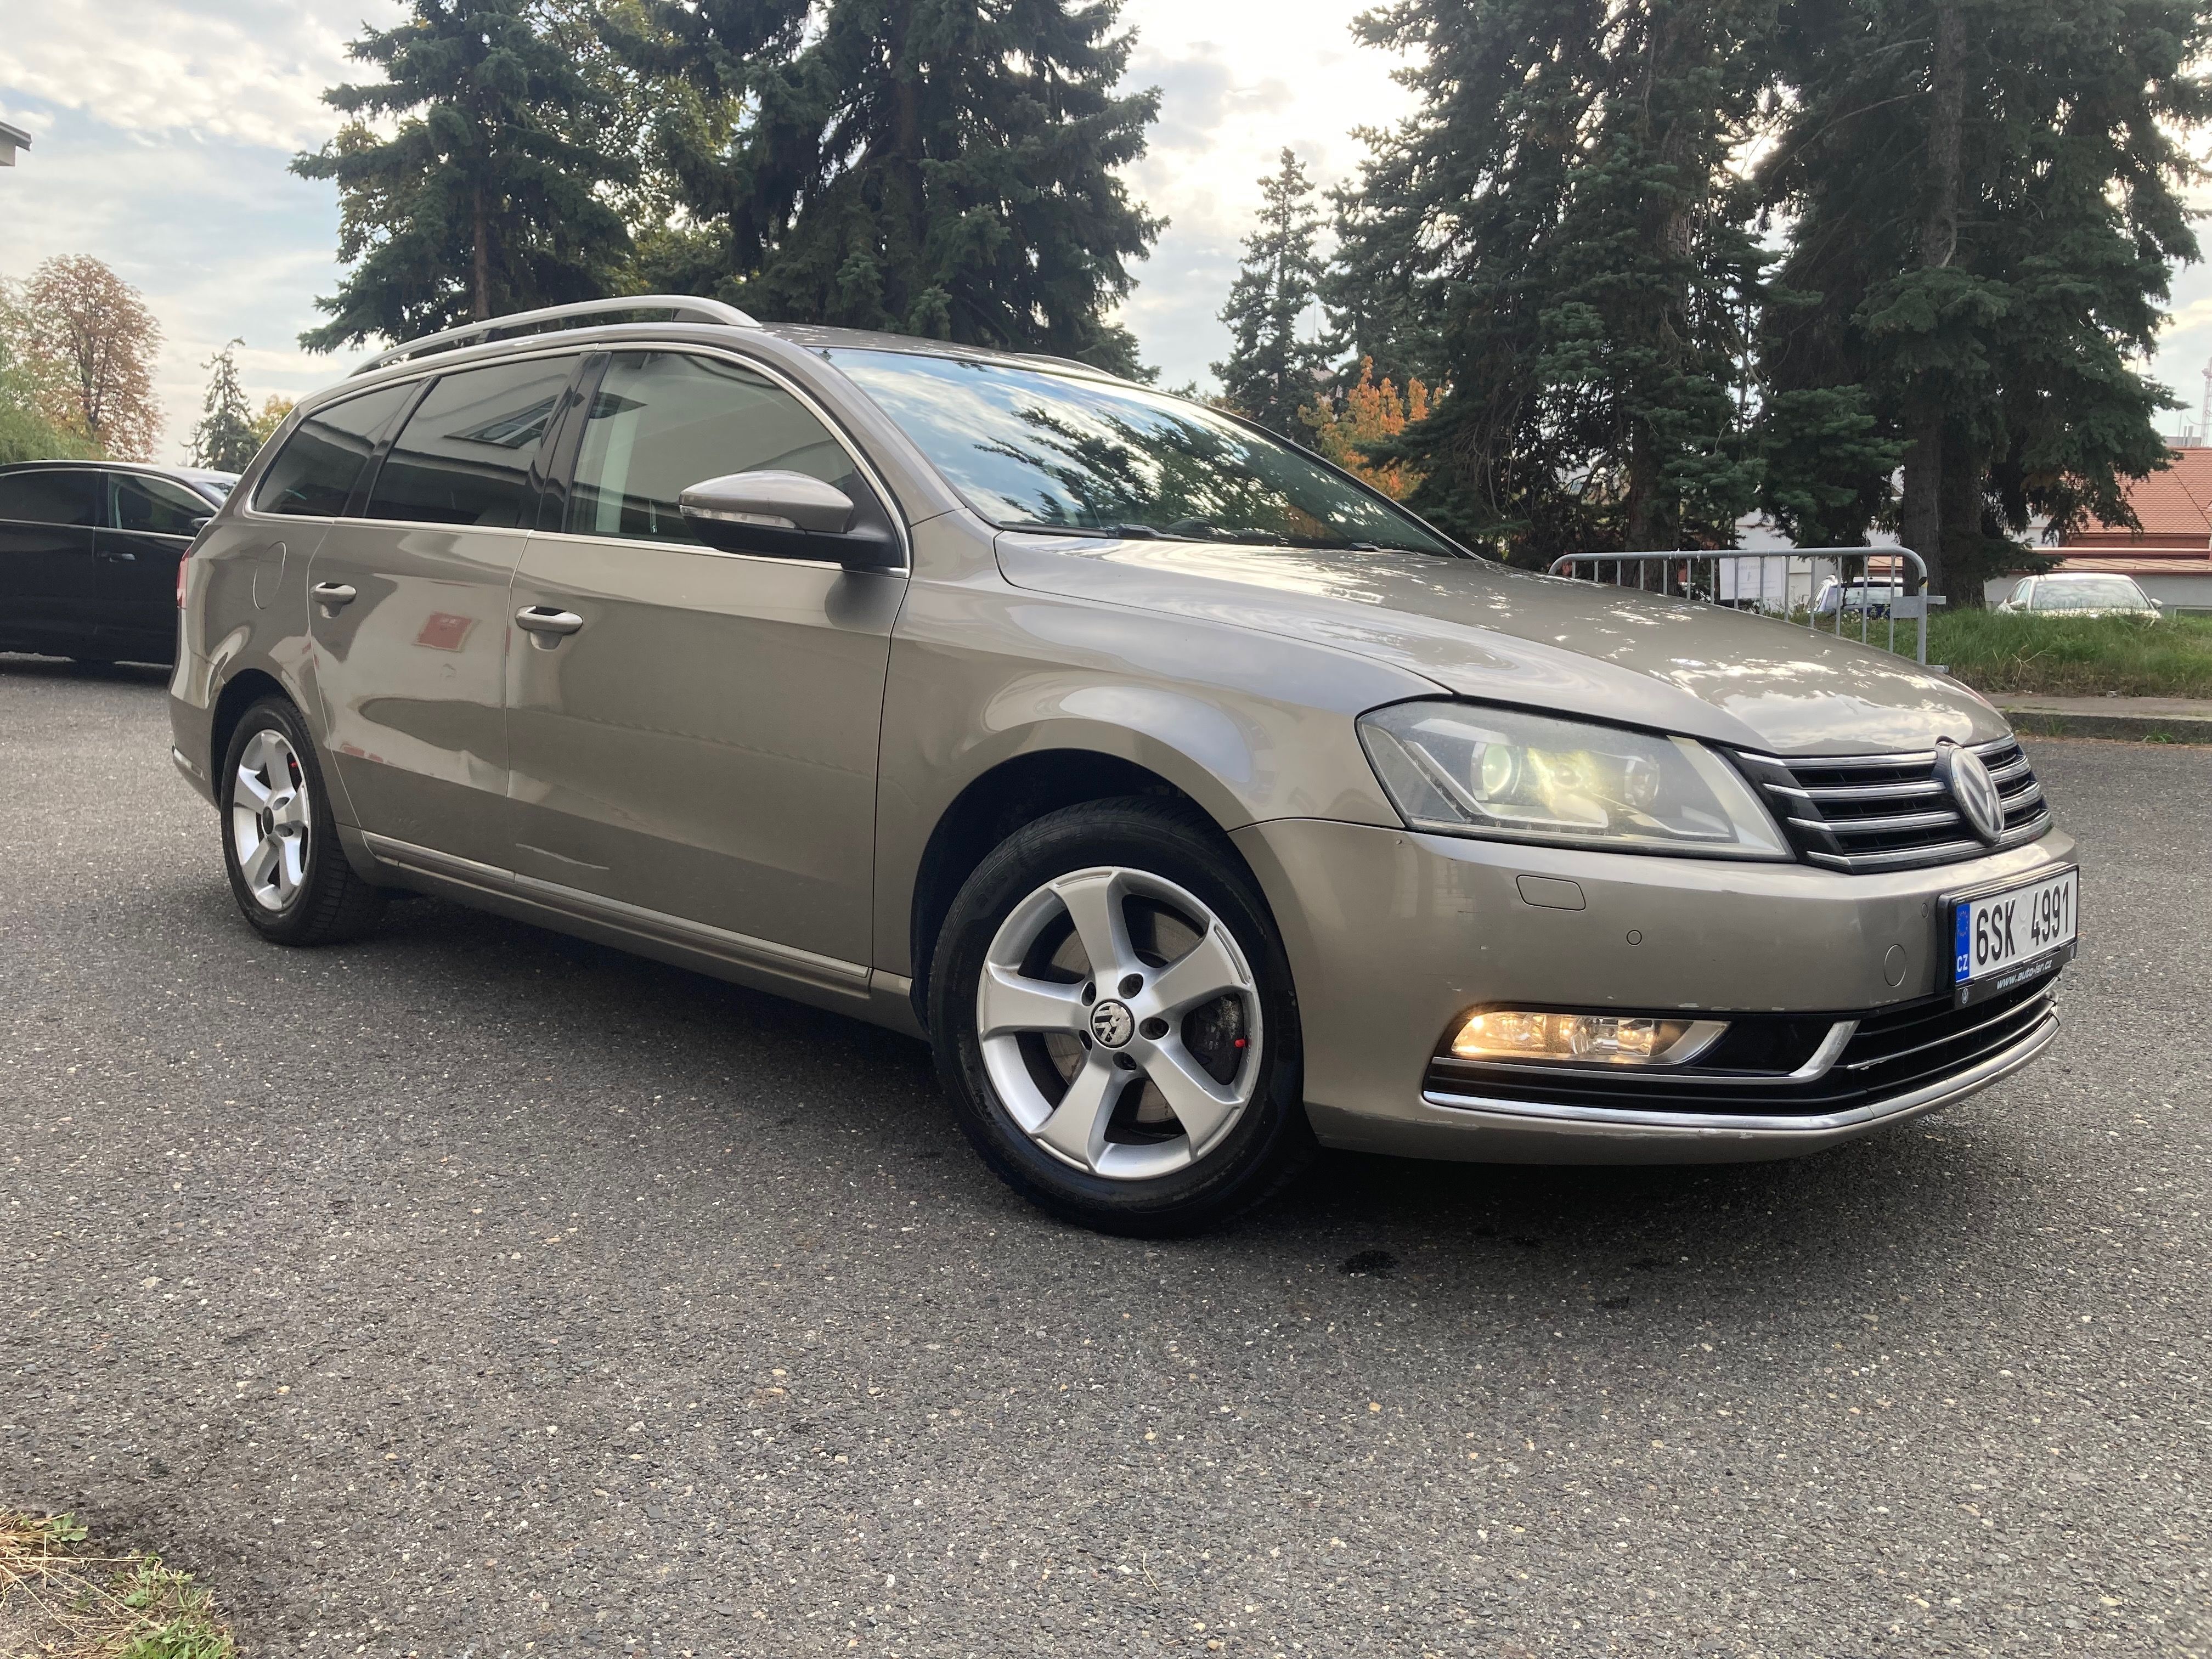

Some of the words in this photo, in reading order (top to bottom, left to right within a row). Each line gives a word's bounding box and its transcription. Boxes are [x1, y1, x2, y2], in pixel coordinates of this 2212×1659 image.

[1976, 897, 2016, 965] 6SK
[2030, 880, 2069, 946] 4991
[1956, 953, 1968, 973] CZ
